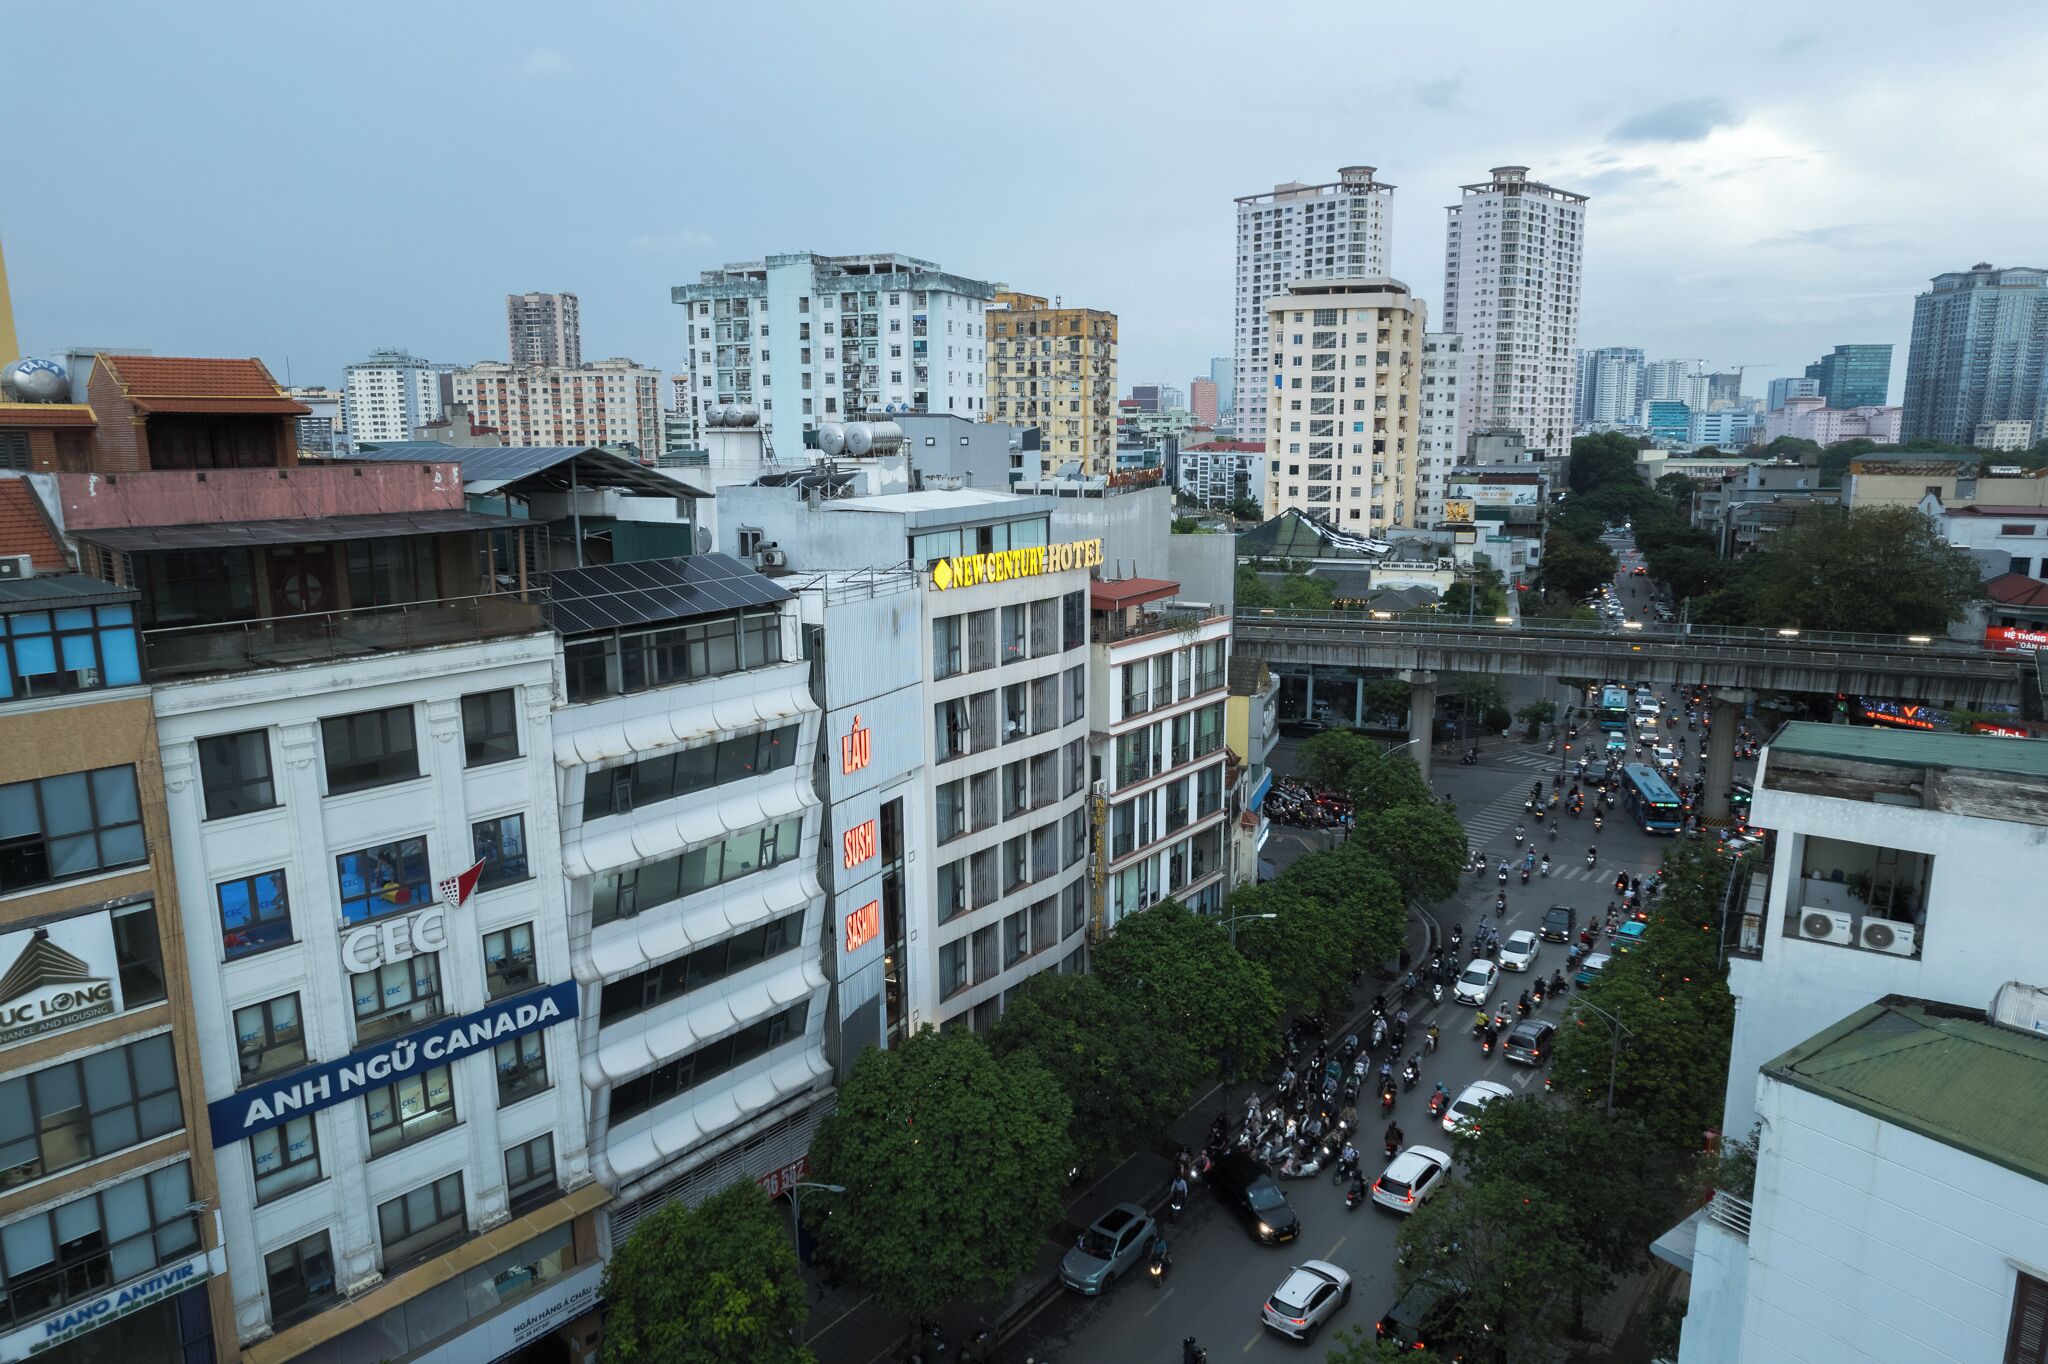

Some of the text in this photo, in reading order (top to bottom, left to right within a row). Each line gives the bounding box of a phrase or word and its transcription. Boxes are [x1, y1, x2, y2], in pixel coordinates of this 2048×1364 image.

[952, 538, 1104, 588] NEW CENTURY HOTEL
[2004, 631, 2046, 642] HỆ THỐNG
[842, 714, 870, 775] LẨU
[844, 819, 876, 870] SUSHI
[342, 908, 448, 974] CEC
[846, 900, 880, 952] SASHIMI
[40, 982, 112, 1016] LONG
[386, 986, 401, 996] CEC
[39, 1018, 62, 1032] AND
[64, 1006, 108, 1024] HOUSING
[244, 997, 560, 1128] ANH NGỮ CANADA
[402, 1096, 417, 1107] CEC
[430, 1086, 444, 1097] CEC
[371, 1110, 386, 1120] CEC
[256, 1152, 273, 1164] CEC
[46, 1264, 194, 1336] NANO ANTIVIR
[514, 1316, 538, 1334] NGÂN
[539, 1302, 562, 1320] HÀNG
[570, 1286, 592, 1303] CHÂU
